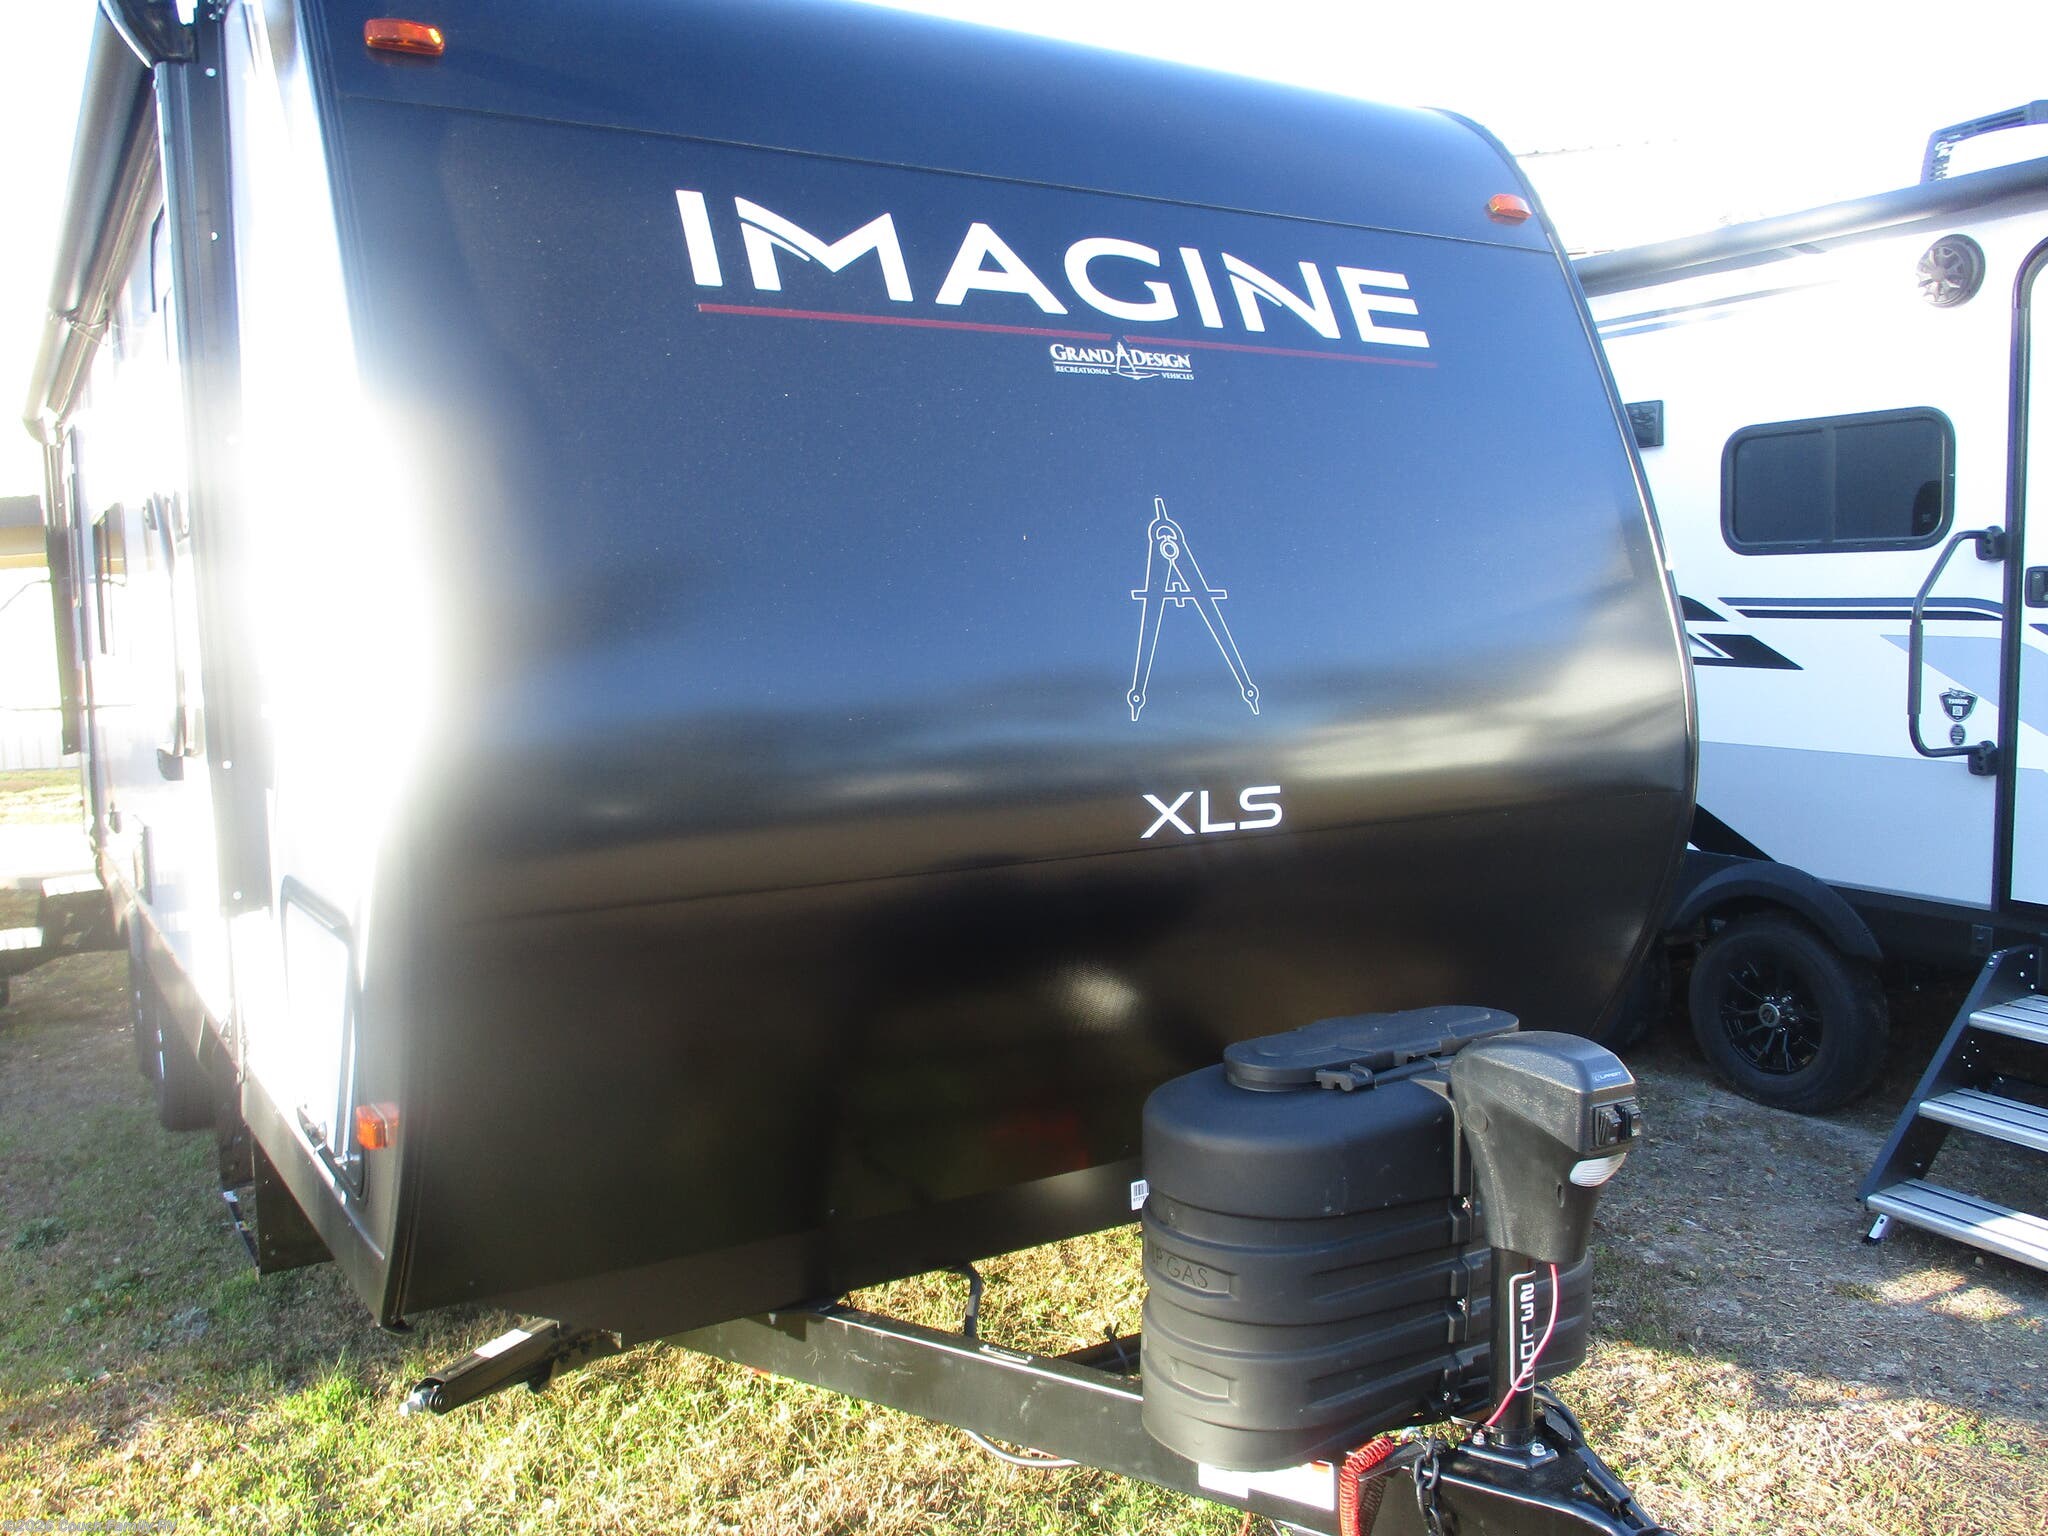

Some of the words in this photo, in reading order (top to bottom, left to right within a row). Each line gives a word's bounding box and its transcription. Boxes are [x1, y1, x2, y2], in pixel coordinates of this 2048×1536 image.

[675, 189, 1430, 348] IMAGINE
[1050, 343, 1115, 364] GRAND
[1131, 349, 1191, 368] DESIGN
[1055, 365, 1110, 375] RECREATIONAL
[1161, 372, 1194, 380] VEHICLES
[1140, 785, 1283, 839] XLS
[1167, 1256, 1208, 1289] GAS
